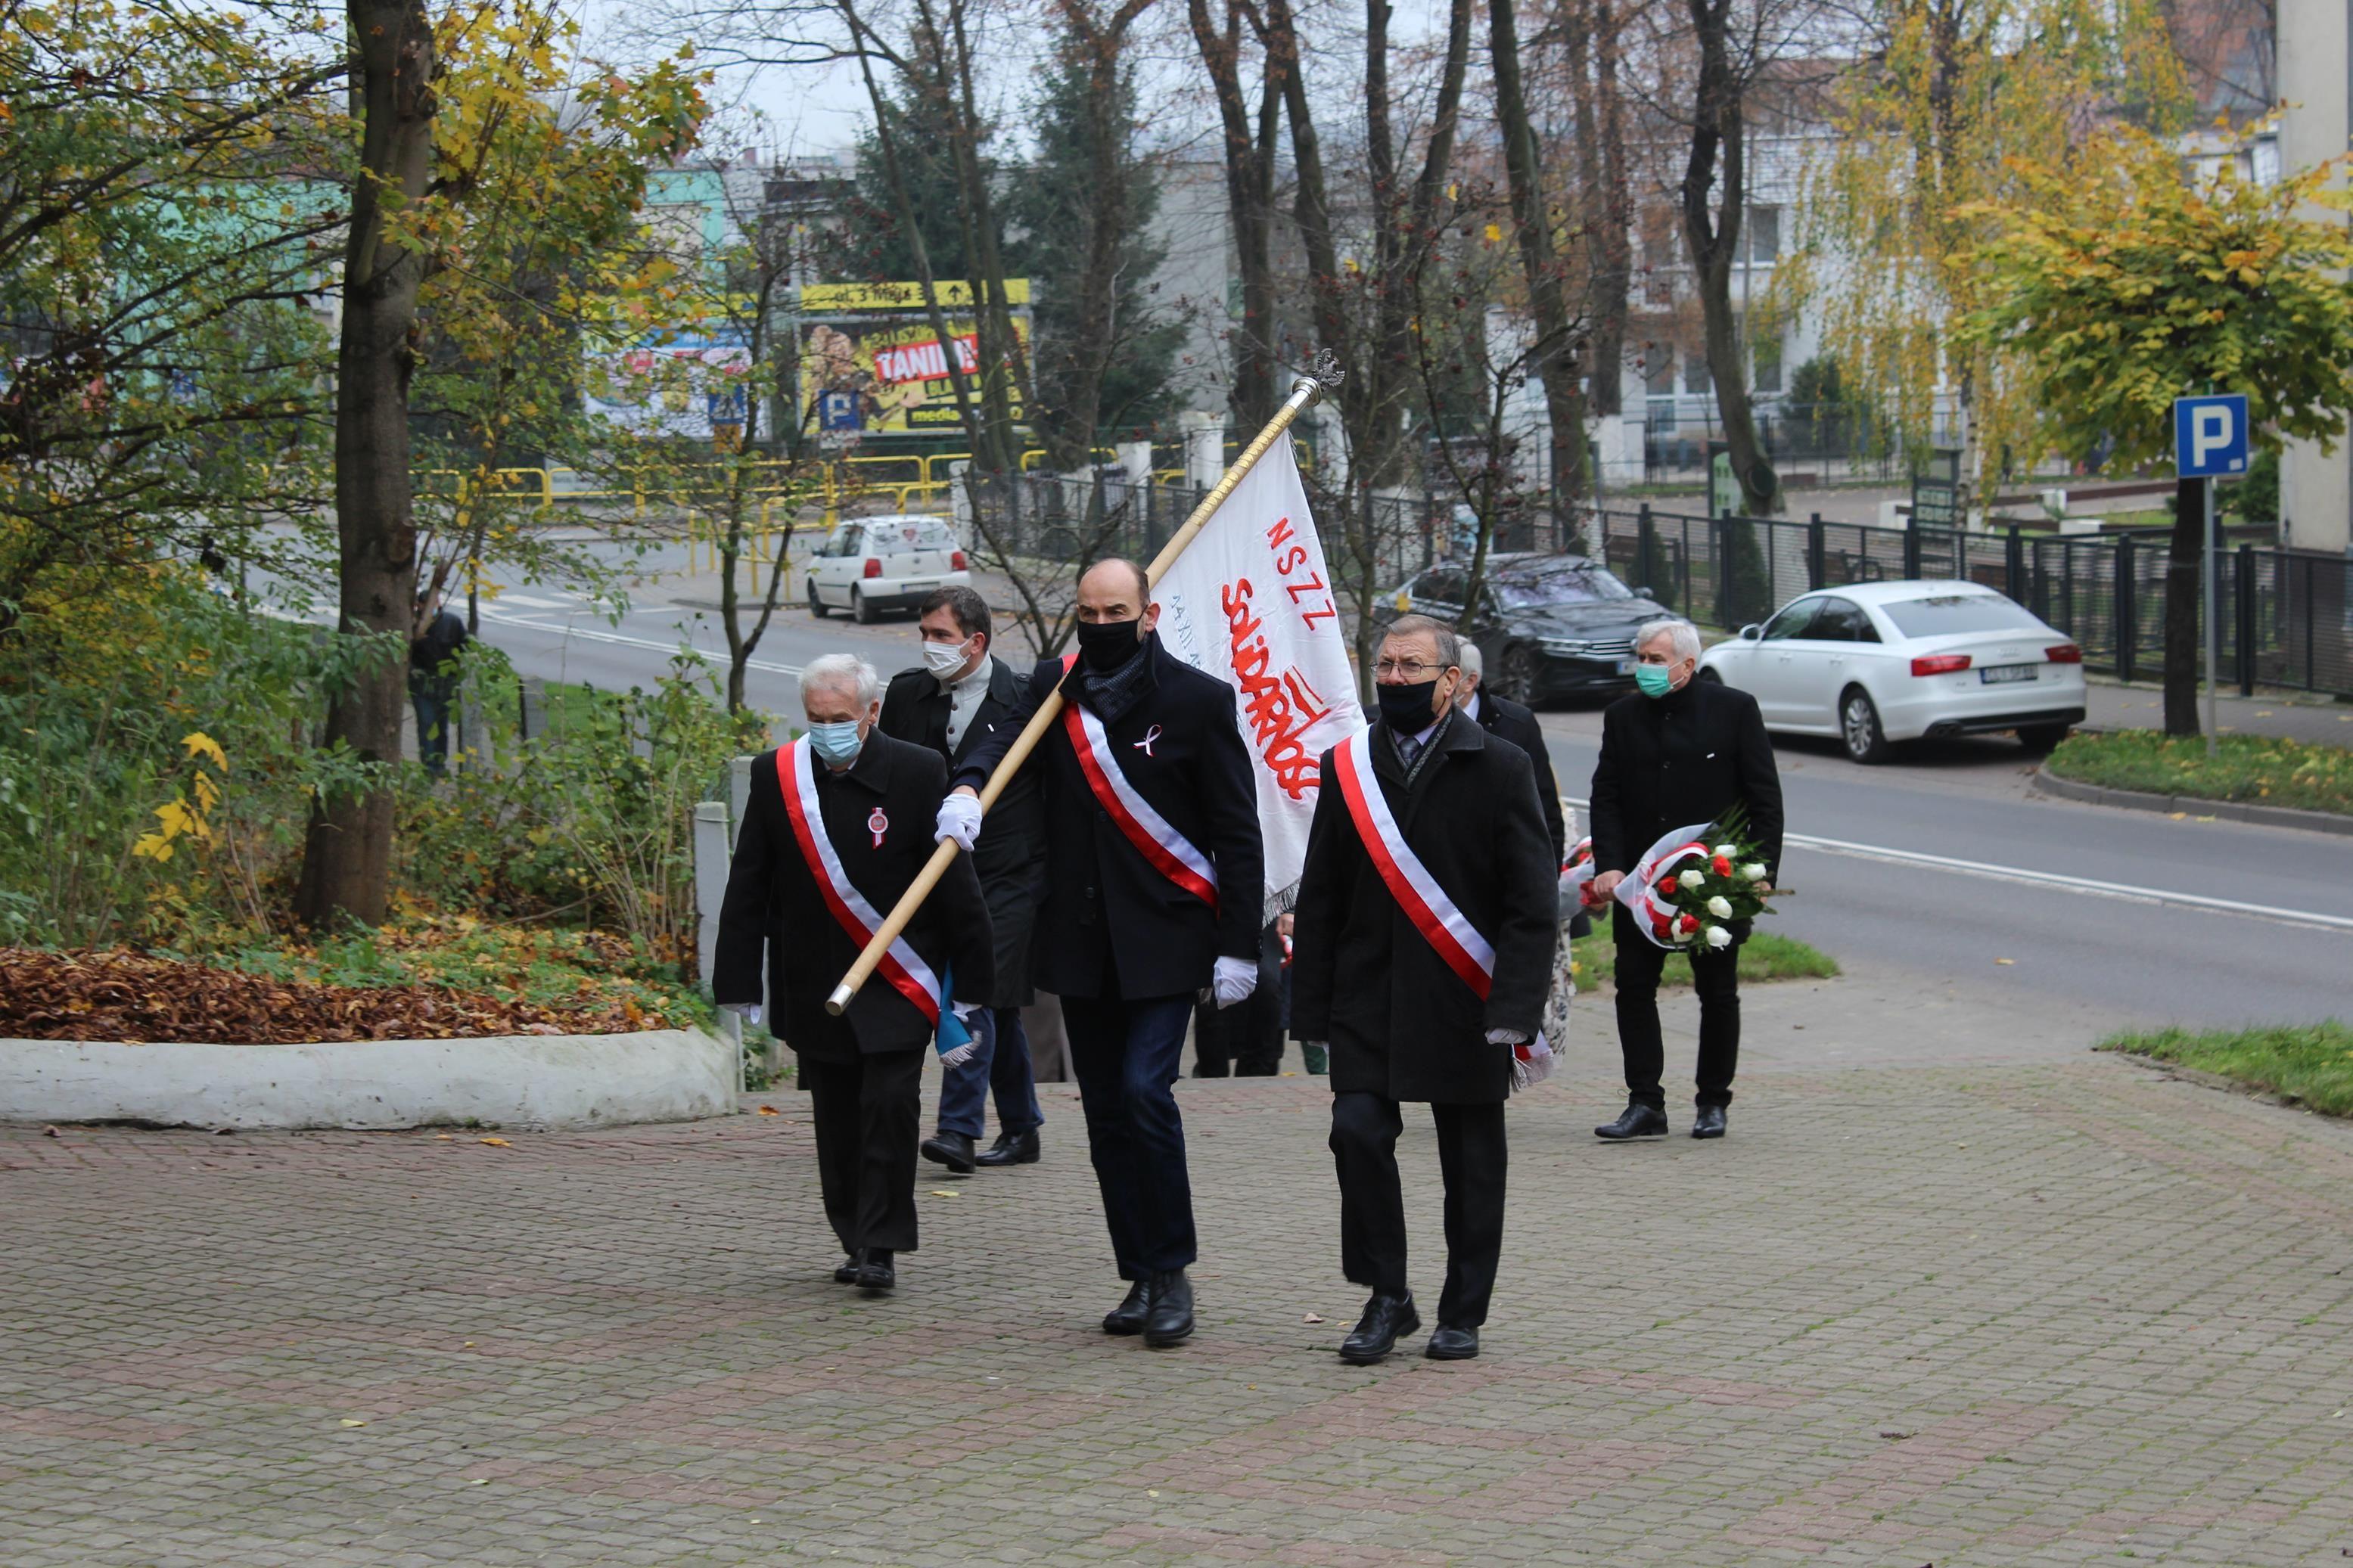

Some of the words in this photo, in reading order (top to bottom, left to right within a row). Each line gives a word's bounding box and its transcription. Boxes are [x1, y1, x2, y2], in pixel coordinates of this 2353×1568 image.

[828, 393, 852, 426] P
[2193, 405, 2233, 467] P
[1267, 517, 1335, 632] NSZZ
